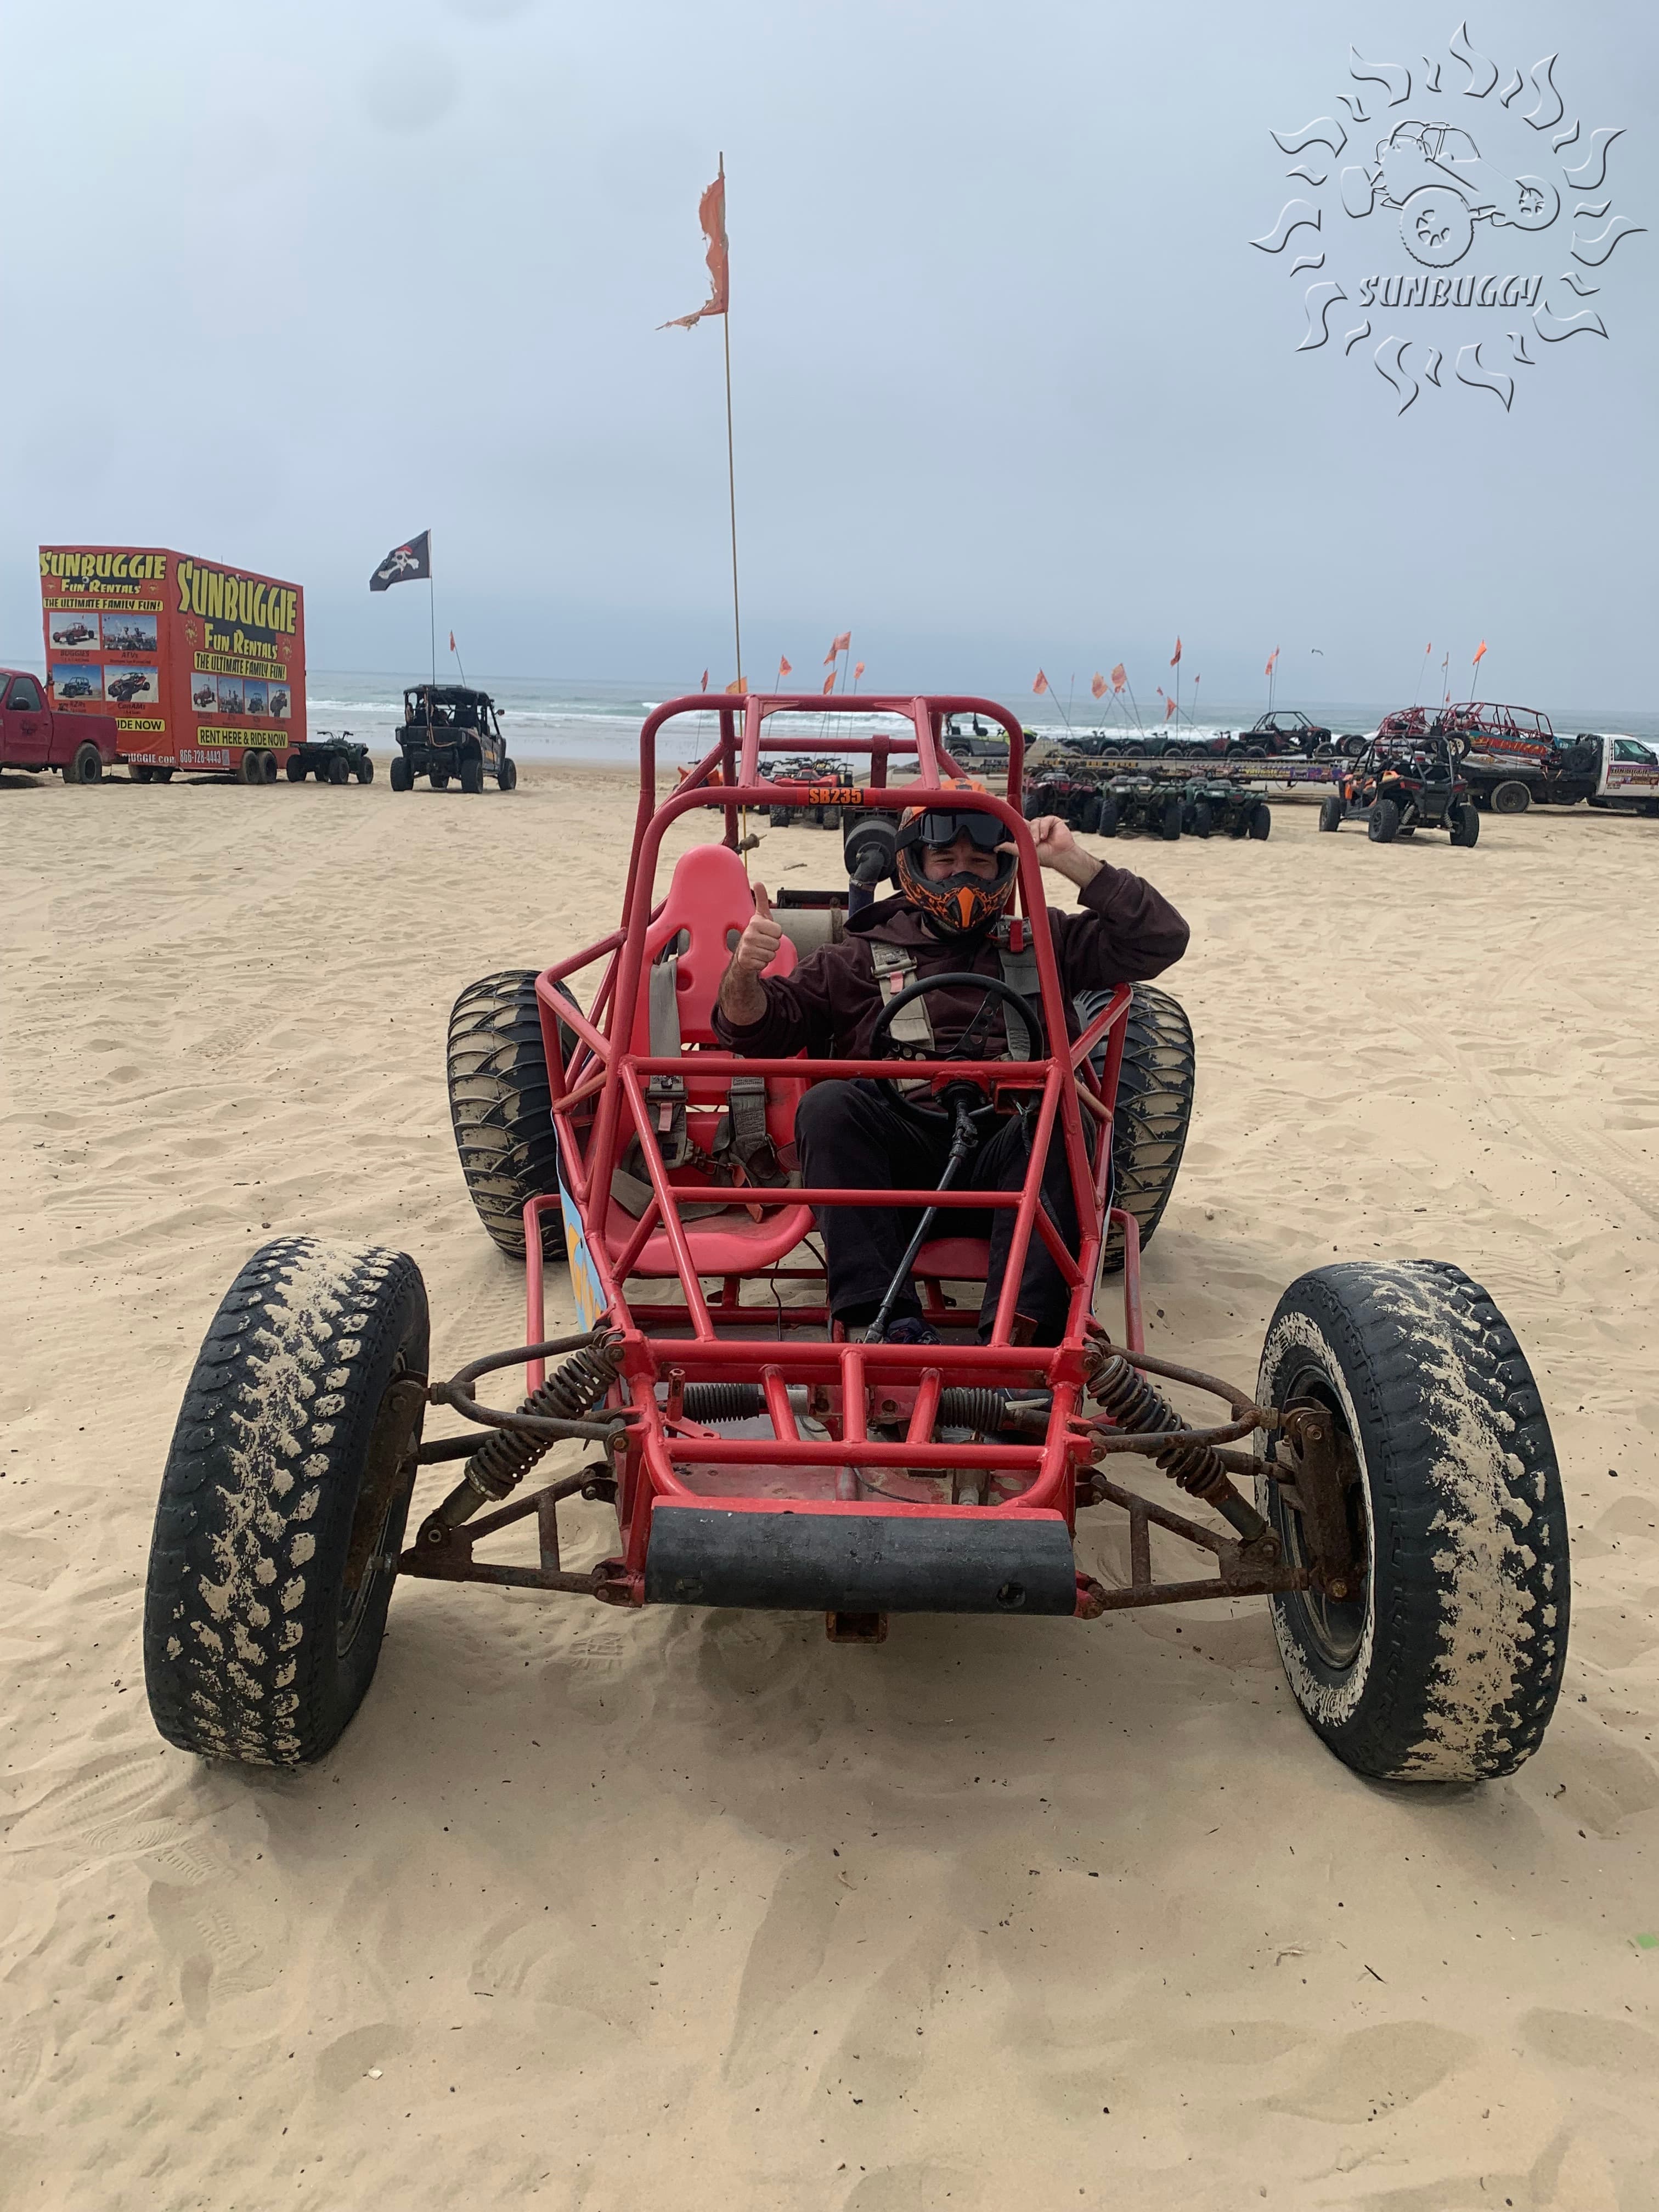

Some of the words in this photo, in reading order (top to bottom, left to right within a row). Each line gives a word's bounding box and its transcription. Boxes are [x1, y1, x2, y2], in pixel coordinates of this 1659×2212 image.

[40, 551, 166, 579] SUNBUGGIE
[44, 598, 58, 607] THE
[60, 599, 100, 608] ULTIMATE
[103, 600, 135, 610] FAMILY
[138, 601, 160, 610] FUN!
[177, 560, 297, 634] SUNBUGGIE
[196, 653, 210, 669] THE
[211, 655, 244, 674] ULTIMATE
[245, 660, 268, 677] FAMILY
[270, 663, 285, 679] FUN!
[117, 719, 132, 729] IDE
[135, 720, 162, 730] NOW
[200, 729, 221, 744] RENT
[222, 730, 242, 745] HERE
[244, 732, 249, 745] &
[250, 732, 267, 746] RIDE
[268, 733, 286, 747] NOW
[179, 749, 222, 764] 866-728-4443
[809, 788, 861, 804] SB235
